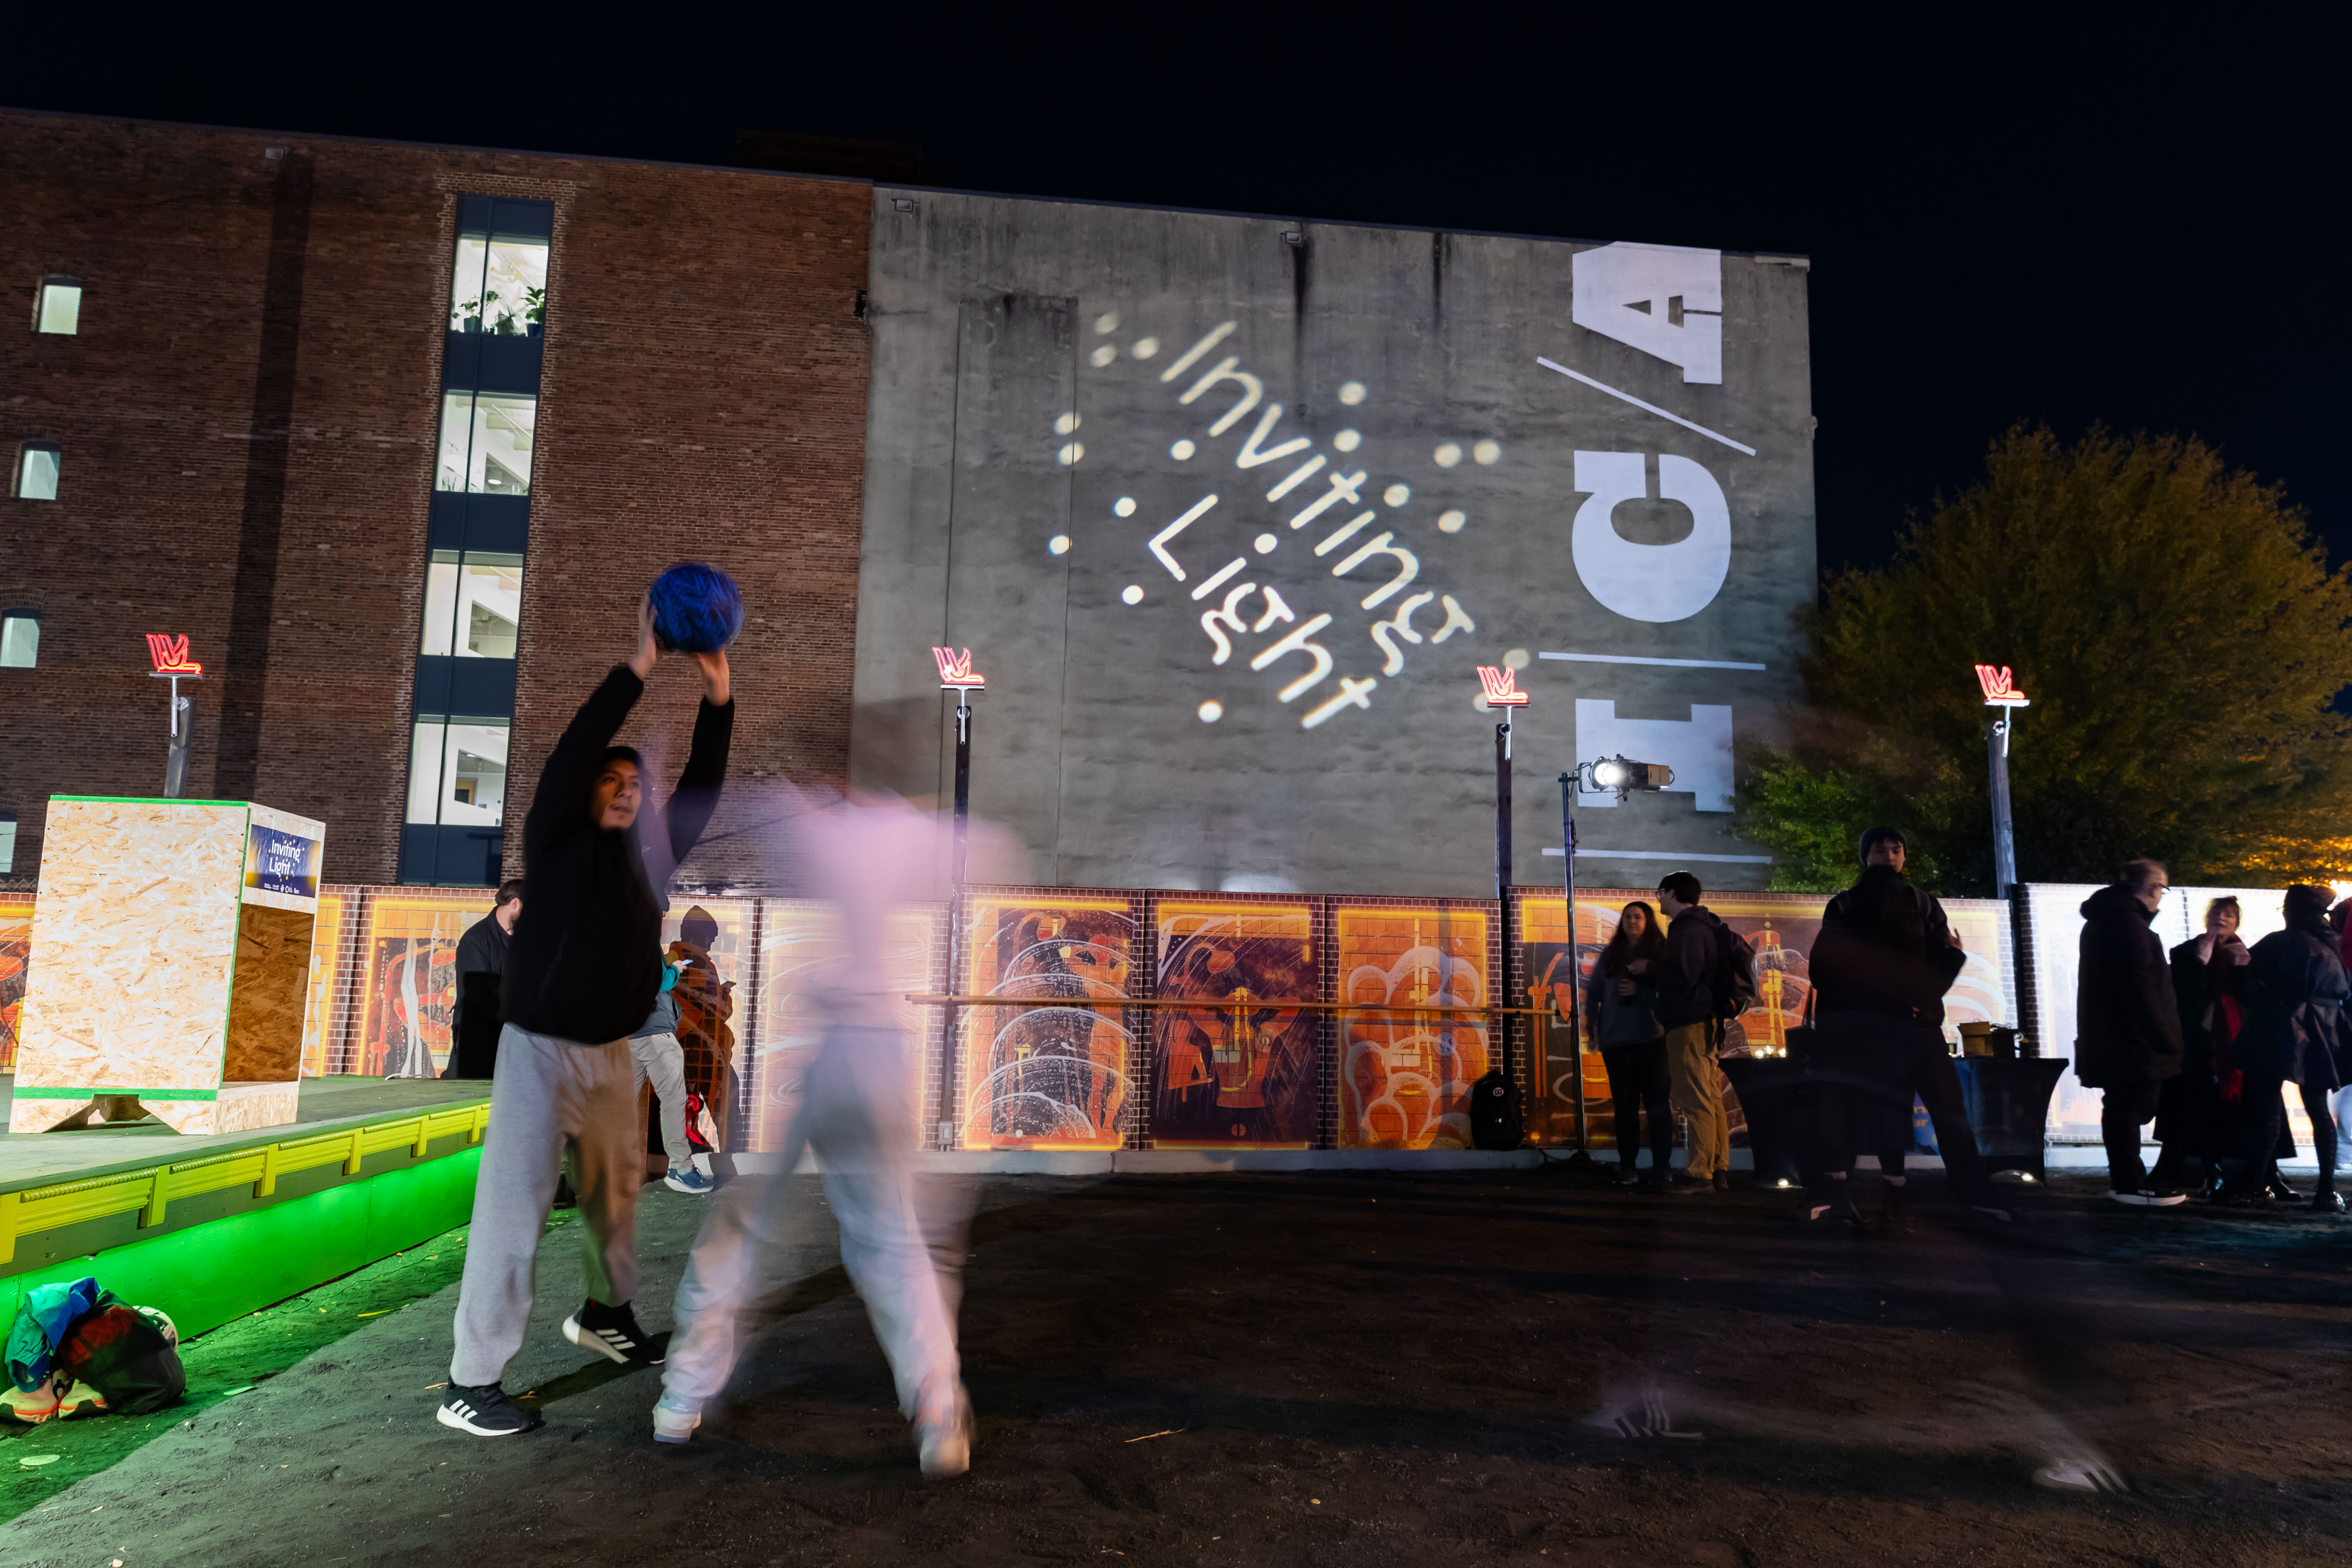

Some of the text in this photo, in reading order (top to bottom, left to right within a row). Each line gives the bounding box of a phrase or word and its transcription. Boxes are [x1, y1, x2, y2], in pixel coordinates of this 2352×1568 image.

[1161, 320, 1475, 677] Inviting
[1148, 494, 1377, 728] Light
[269, 858, 291, 878] Light
[271, 839, 301, 863] Inviting
